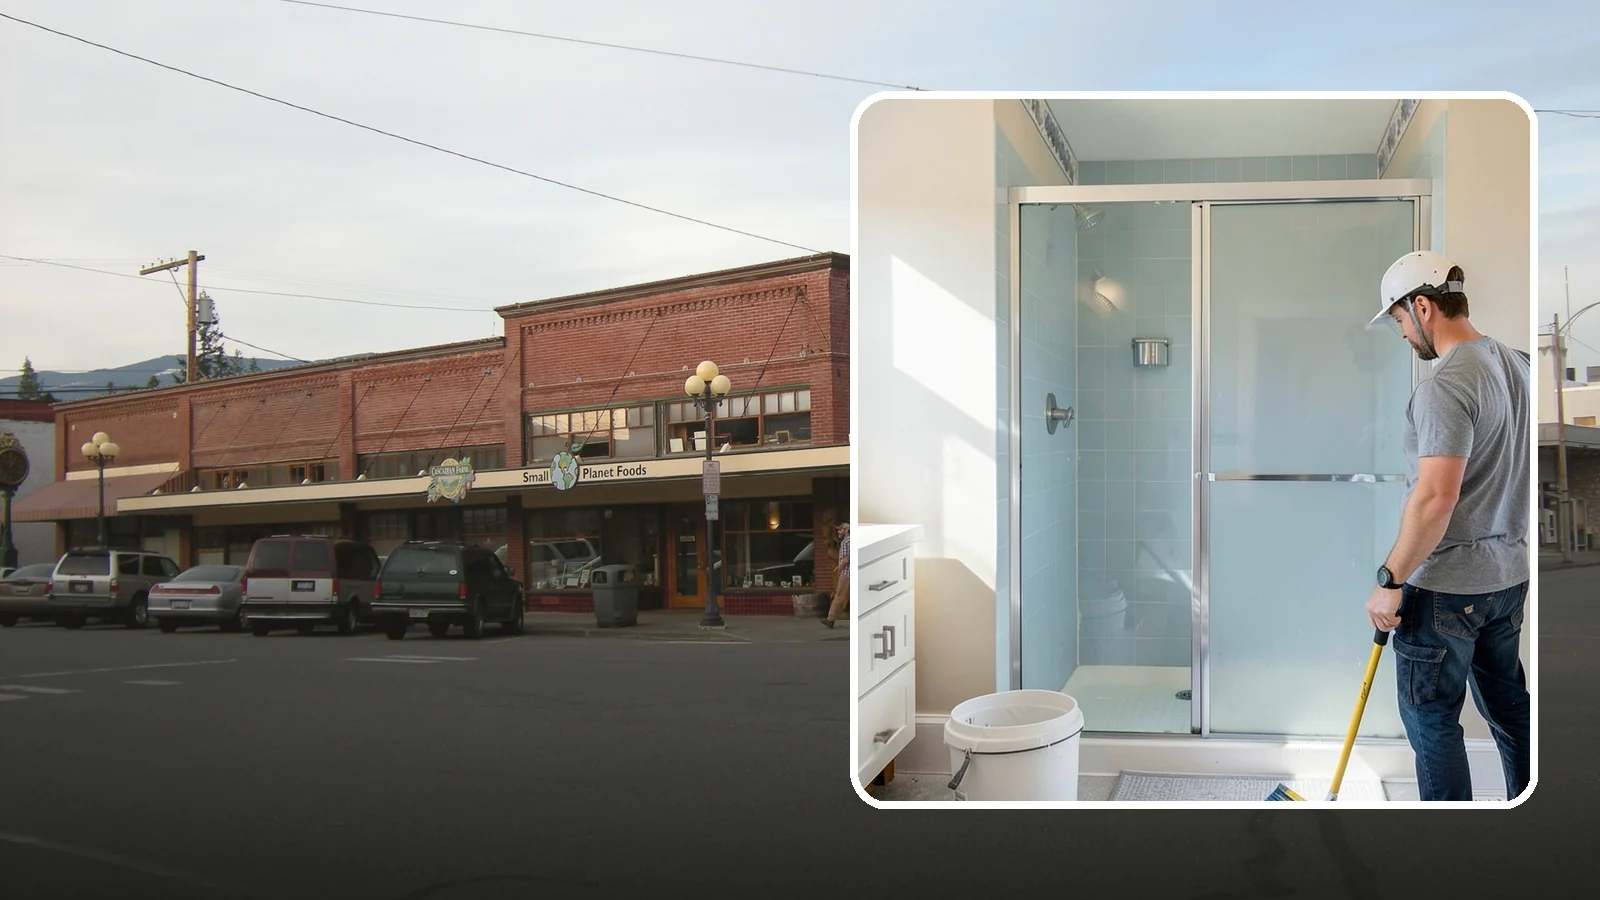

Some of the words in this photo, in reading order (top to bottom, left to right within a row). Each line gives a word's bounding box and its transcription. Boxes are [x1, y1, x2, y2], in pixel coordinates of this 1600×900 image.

[523, 471, 549, 483] Small
[582, 467, 614, 479] Planet
[616, 464, 647, 477] Foods
